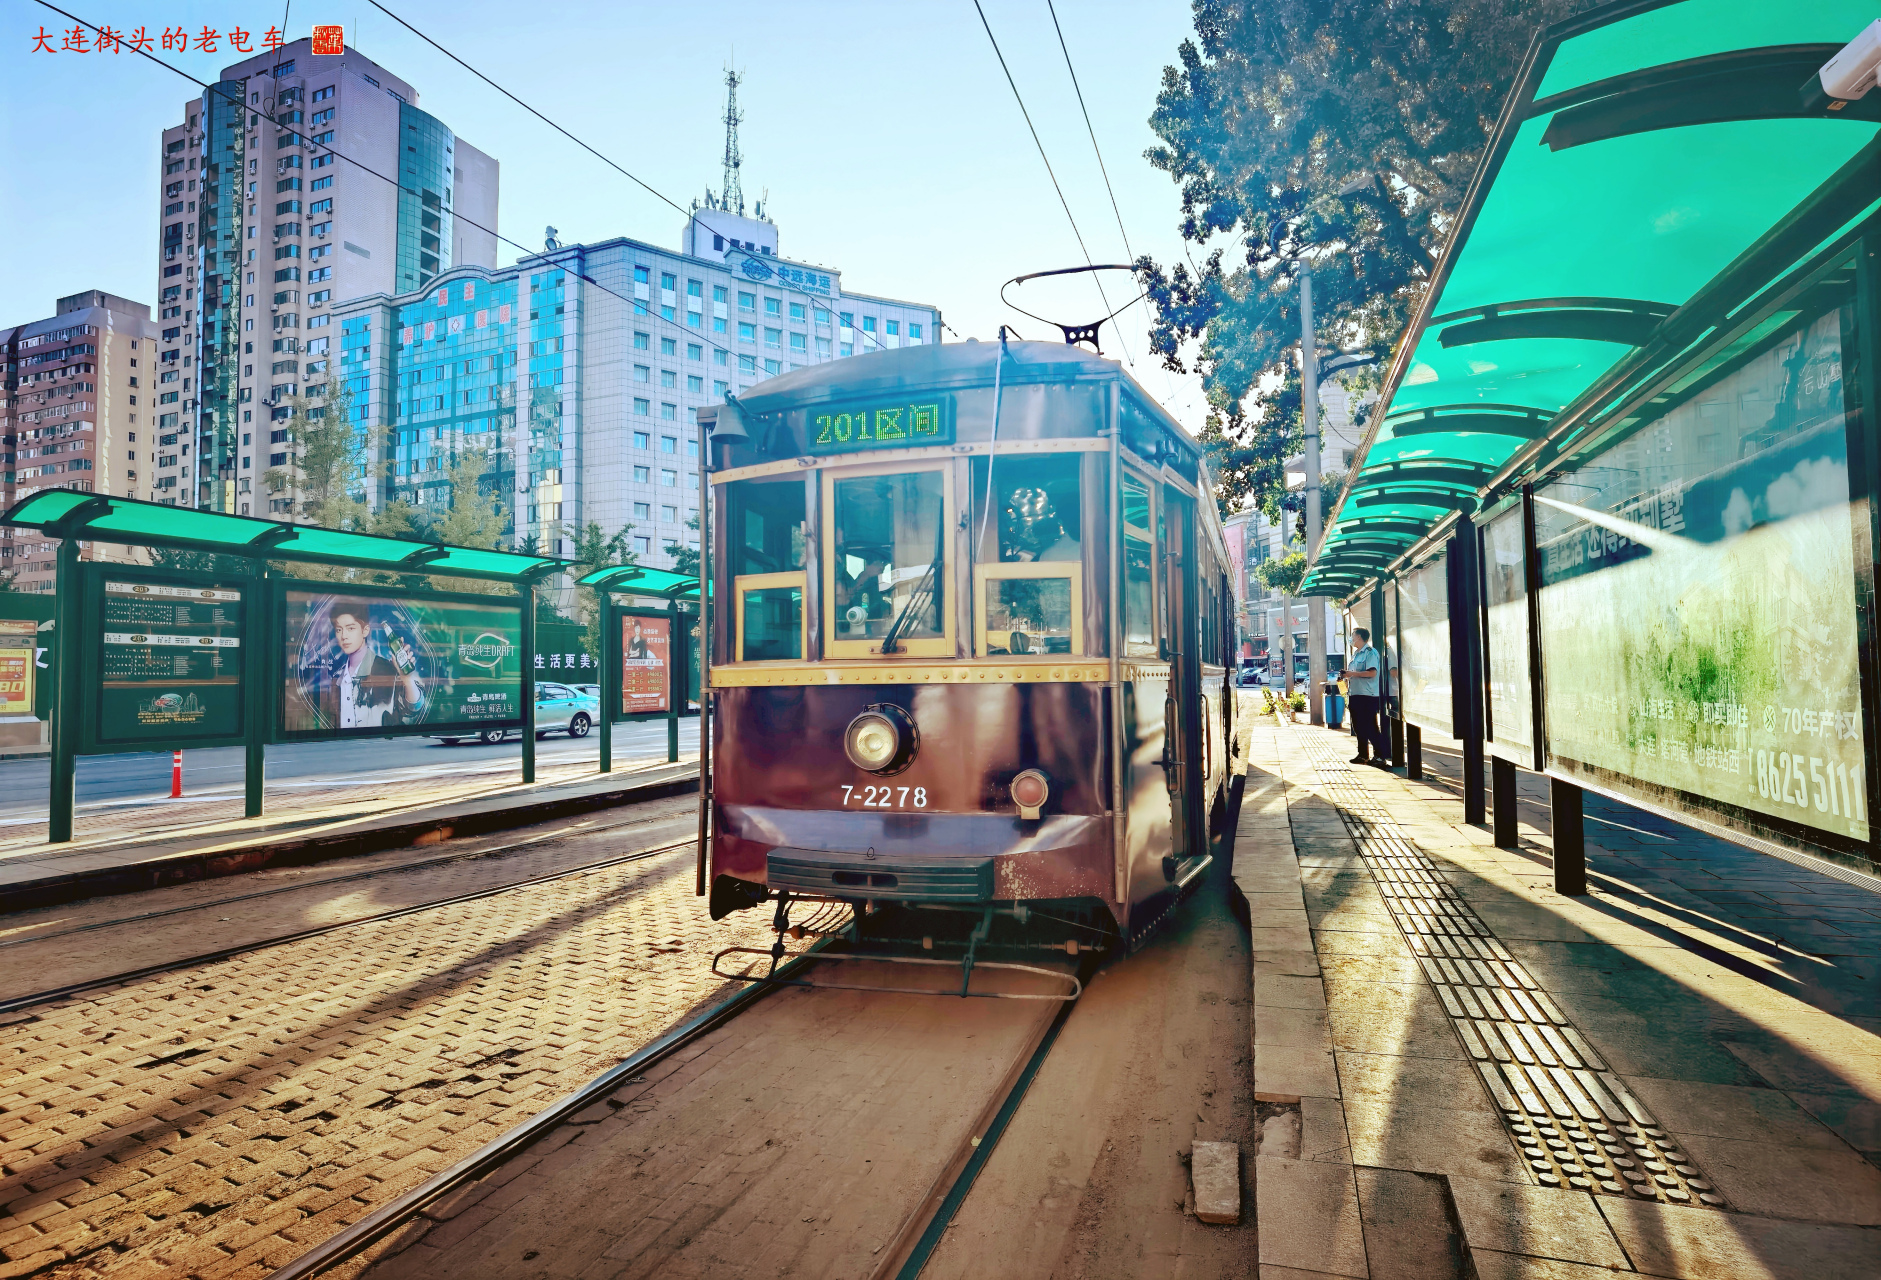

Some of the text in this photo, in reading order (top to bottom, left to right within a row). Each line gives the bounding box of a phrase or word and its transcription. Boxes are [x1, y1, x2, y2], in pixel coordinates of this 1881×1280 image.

[778, 265, 831, 290] 中远海运
[778, 280, 831, 296] COSCO SHIPPING
[439, 282, 475, 306] 民主
[477, 305, 511, 328] 医院
[816, 403, 939, 444] 201区间
[132, 635, 146, 643] 201
[535, 653, 599, 669] 生活更美
[1781, 707, 1859, 741] 70年产权
[841, 785, 927, 808] 7-2278
